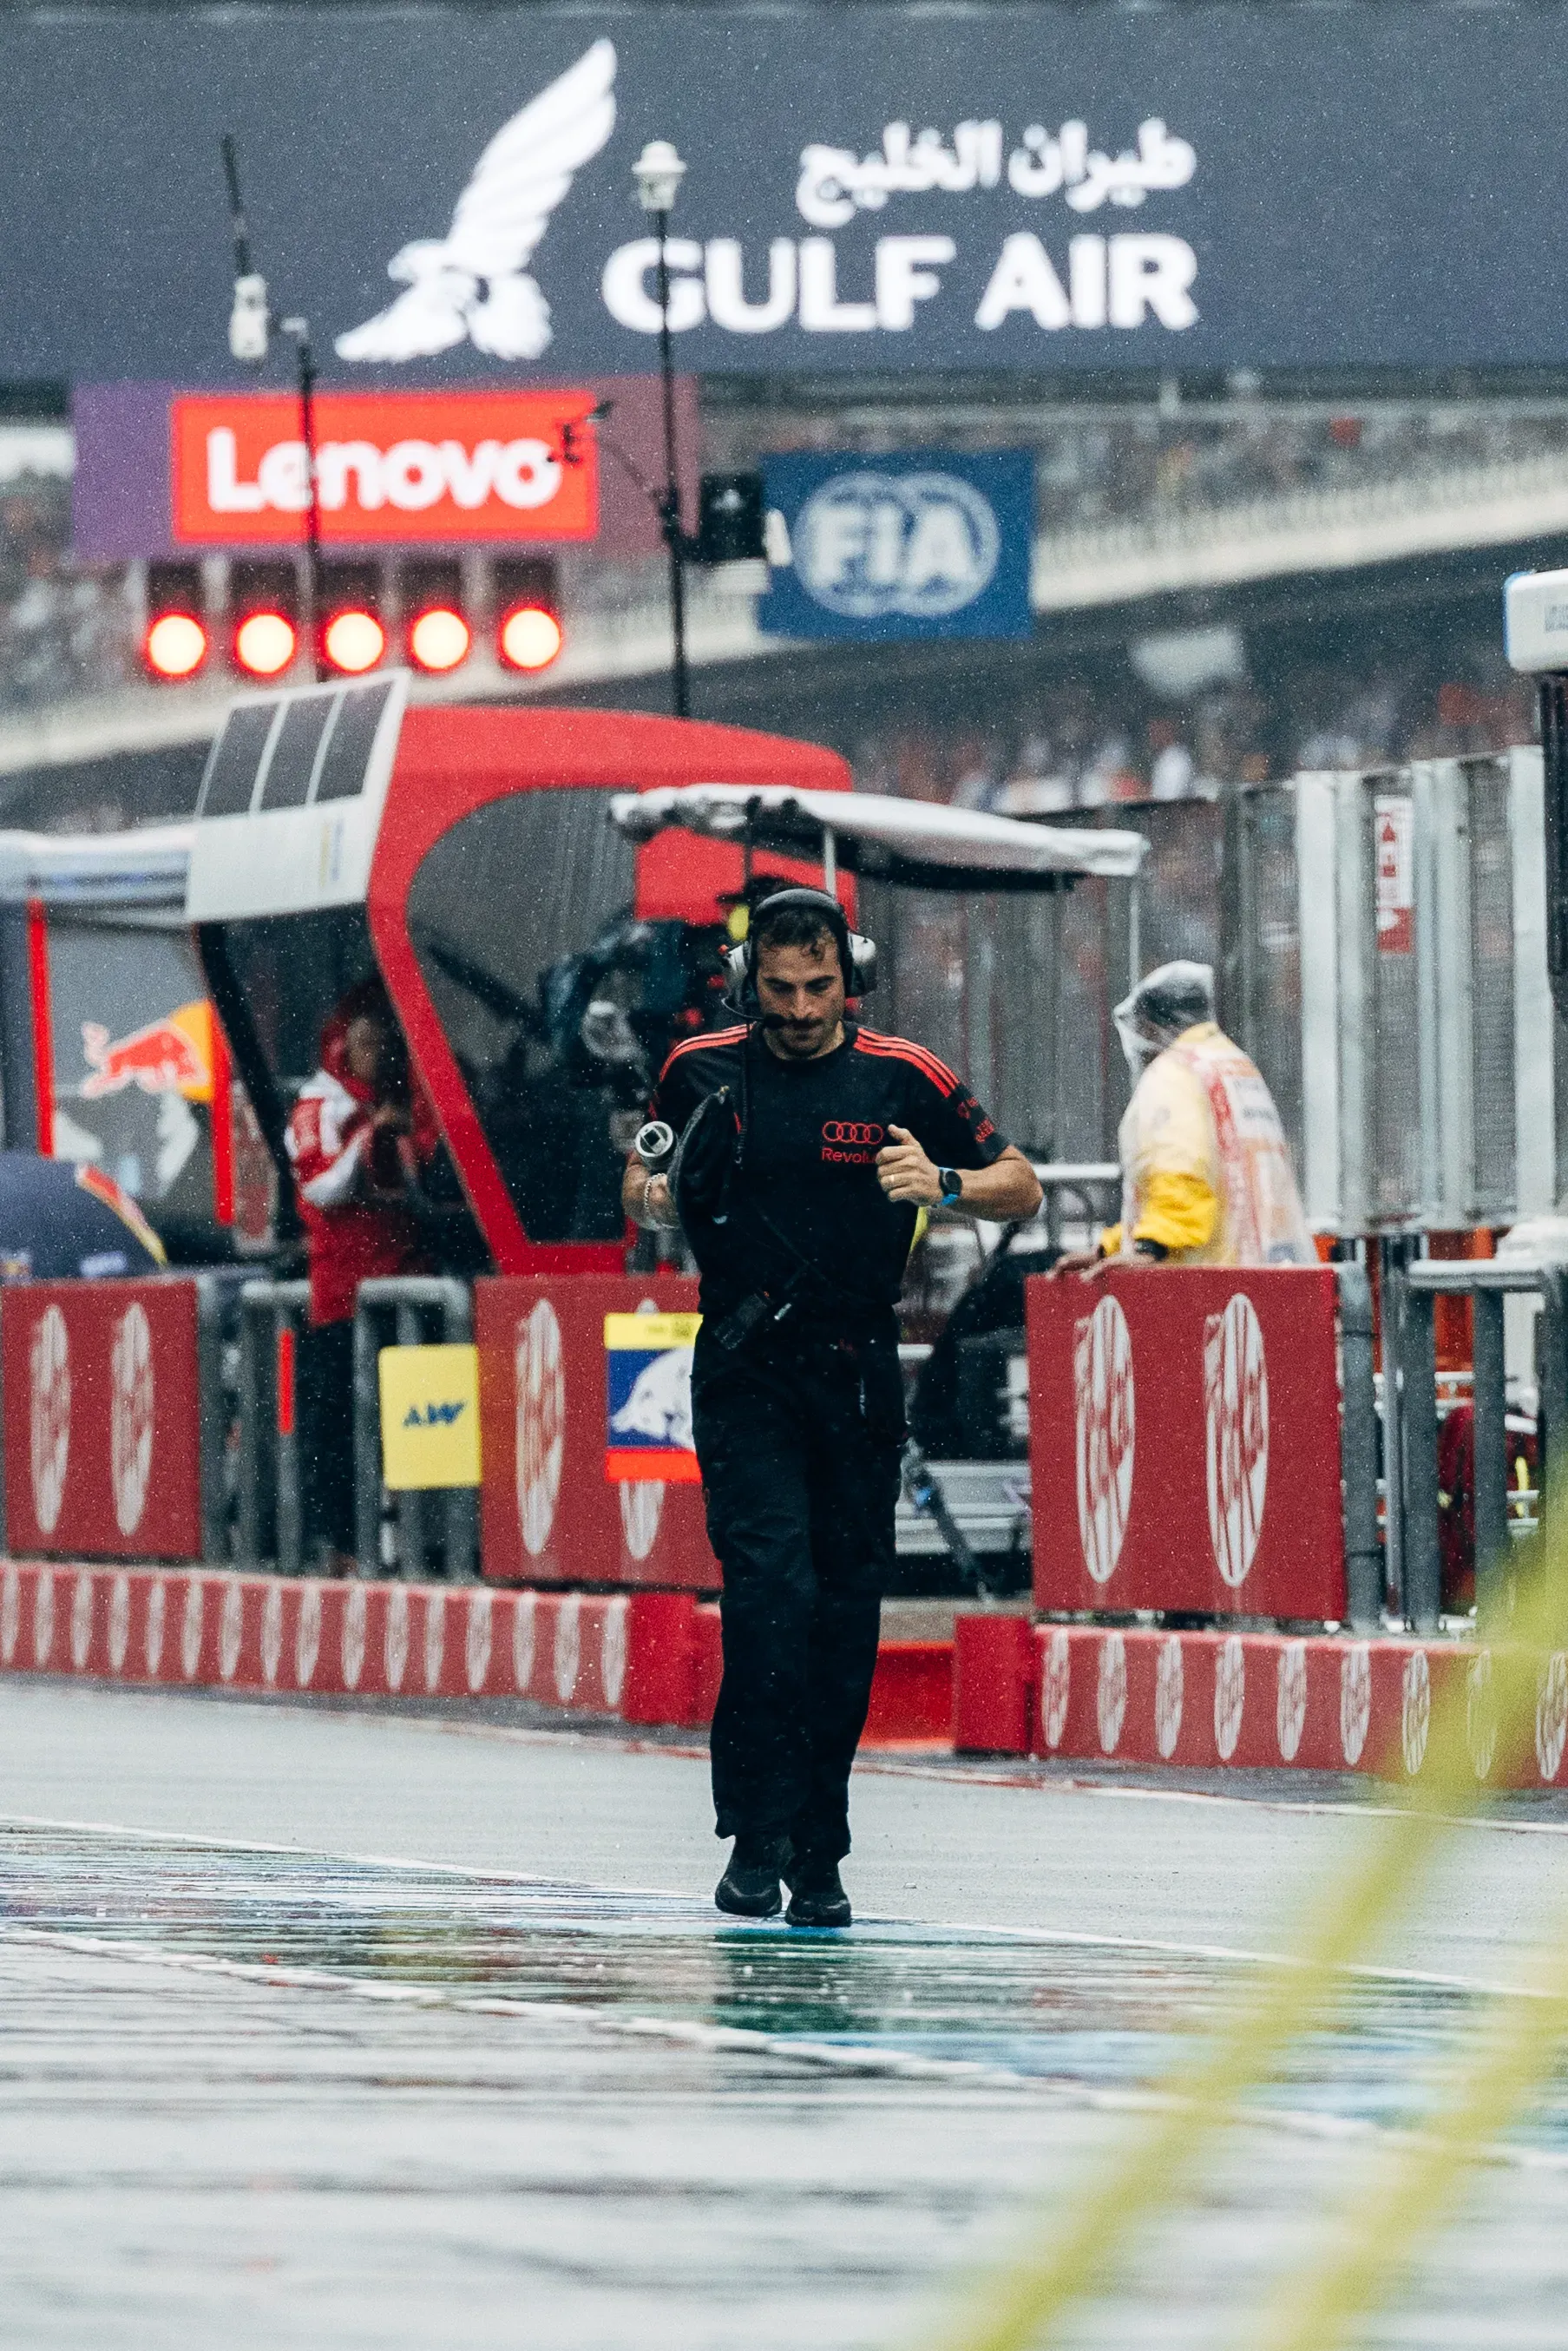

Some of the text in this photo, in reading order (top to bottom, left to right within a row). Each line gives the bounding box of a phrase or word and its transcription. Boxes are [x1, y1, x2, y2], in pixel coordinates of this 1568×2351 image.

[796, 118, 1197, 228] طيران الخليج
[602, 232, 1198, 333] GULF AIR
[207, 426, 562, 513] Lenovo
[809, 505, 978, 589] FIA
